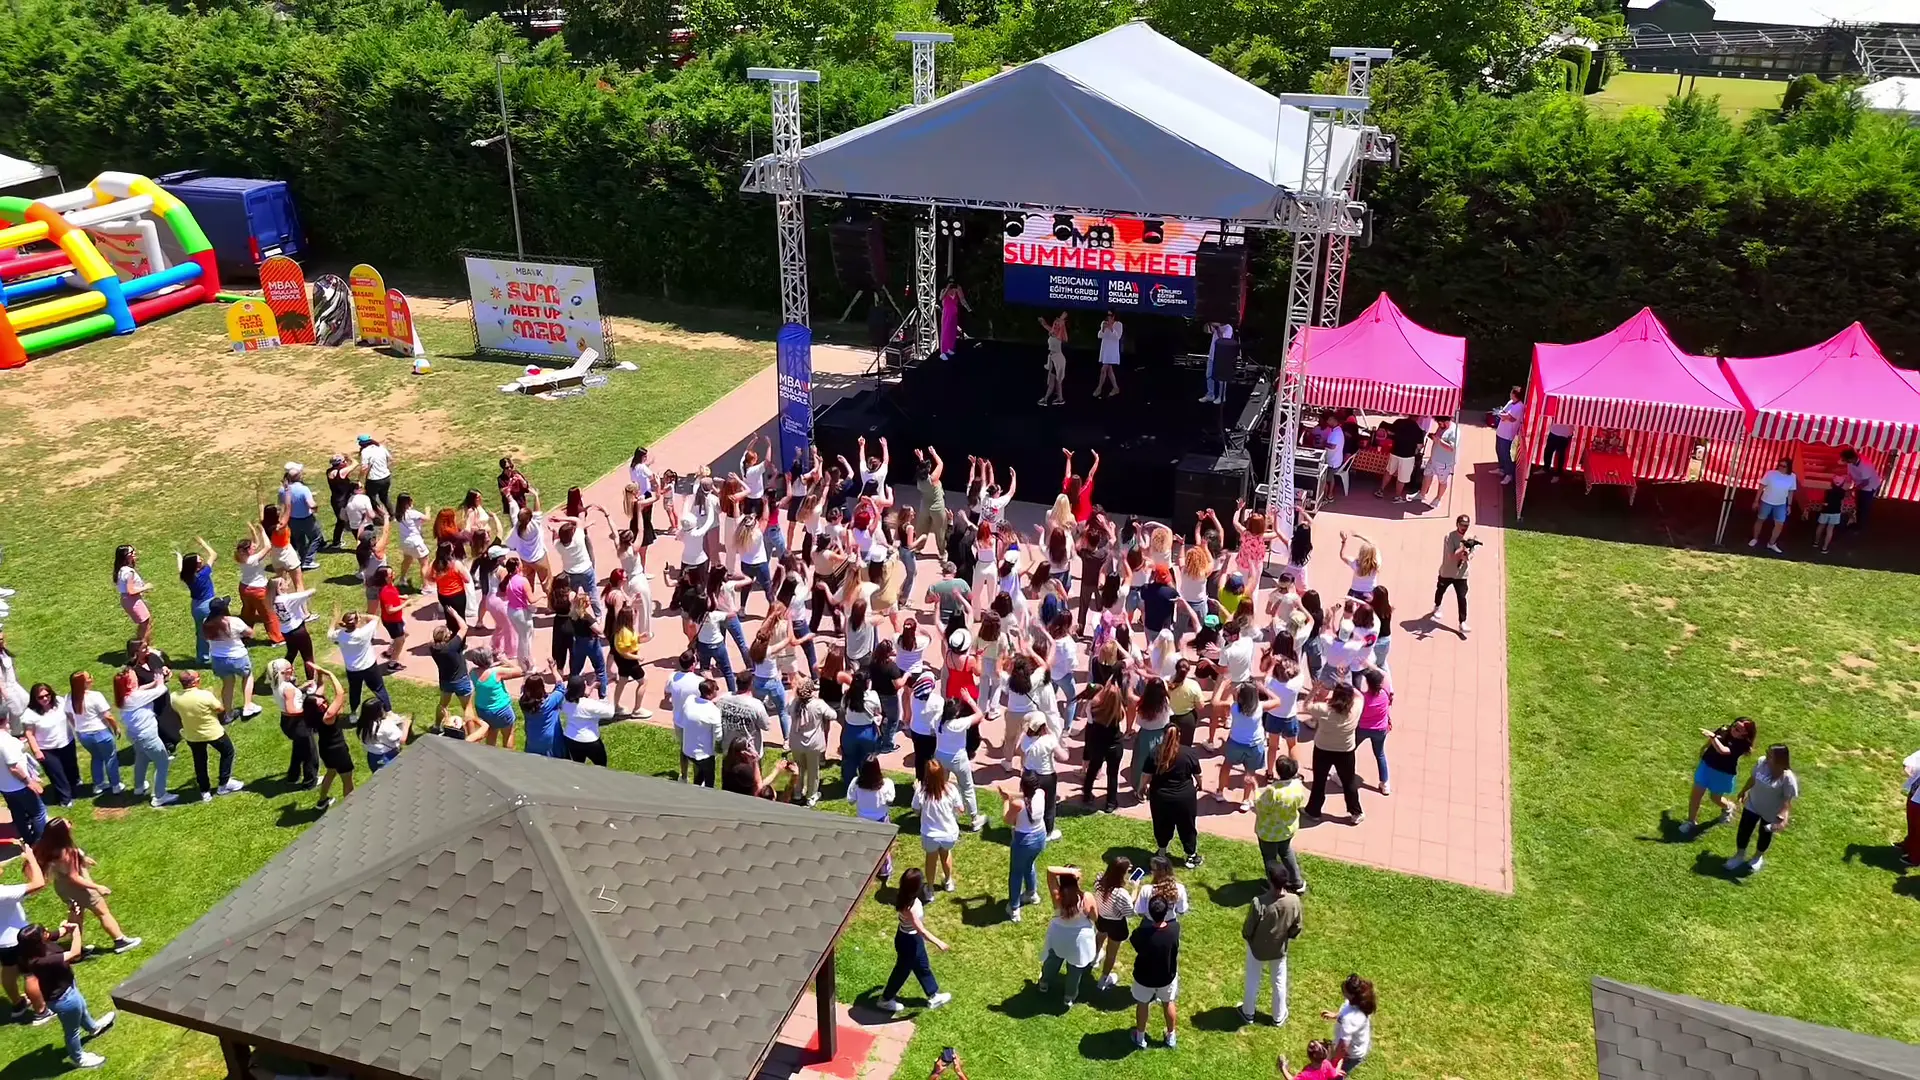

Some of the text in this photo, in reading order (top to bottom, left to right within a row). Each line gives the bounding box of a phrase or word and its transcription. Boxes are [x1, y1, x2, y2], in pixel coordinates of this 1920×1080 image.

[1004, 242, 1196, 277] SUMMER MEET
[1049, 275, 1094, 287] MEDICANA
[1108, 280, 1133, 292] MBA
[1108, 297, 1139, 305] SCHOOLS
[510, 304, 562, 319] MEET UP
[512, 319, 567, 344] MER
[779, 372, 802, 390] MBA
[779, 391, 808, 405] SCHOOLS
